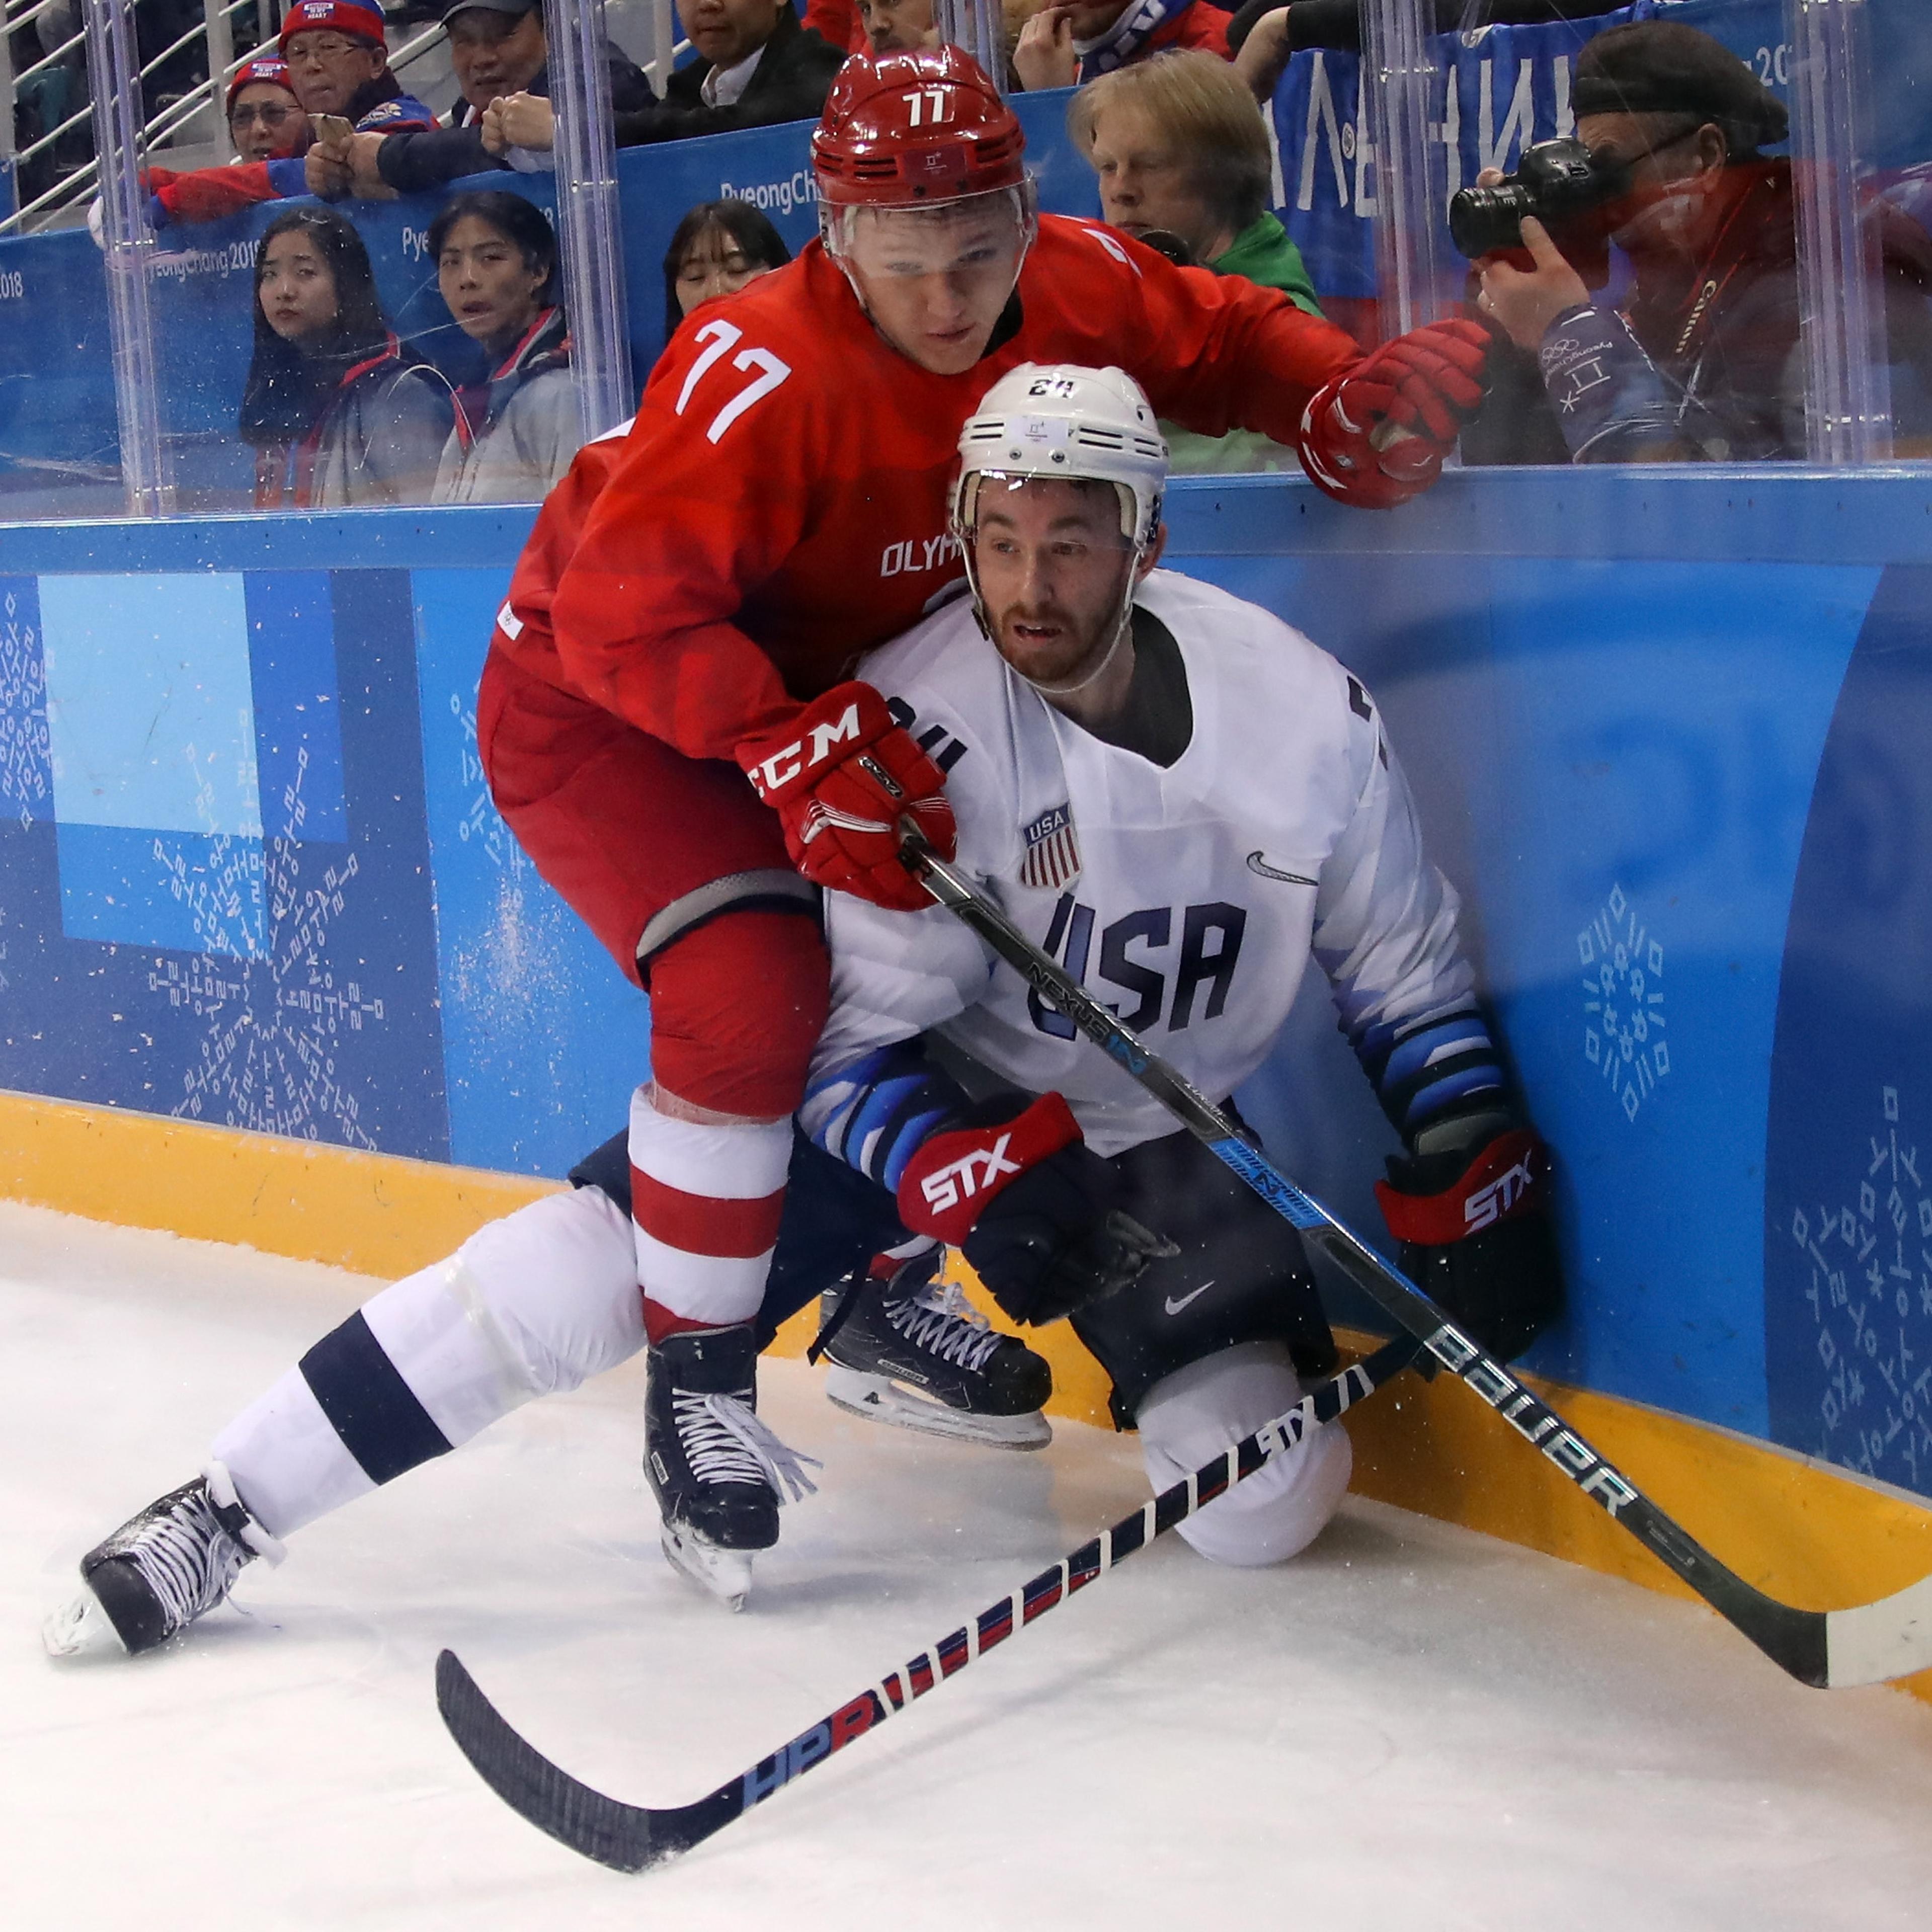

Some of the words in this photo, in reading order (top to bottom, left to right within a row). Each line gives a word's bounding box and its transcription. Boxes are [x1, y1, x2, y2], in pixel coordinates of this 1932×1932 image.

[902, 91, 944, 127] 77
[0, 271, 23, 299] 018
[675, 319, 792, 444] 77
[881, 533, 962, 577] OLYM
[1029, 811, 1064, 841] USA
[1027, 892, 1247, 1041] USA
[1027, 961, 1110, 1042] NEXUS
[921, 1132, 1021, 1216] STX
[1465, 1149, 1533, 1236] STX
[1423, 1323, 1639, 1517] BAUER
